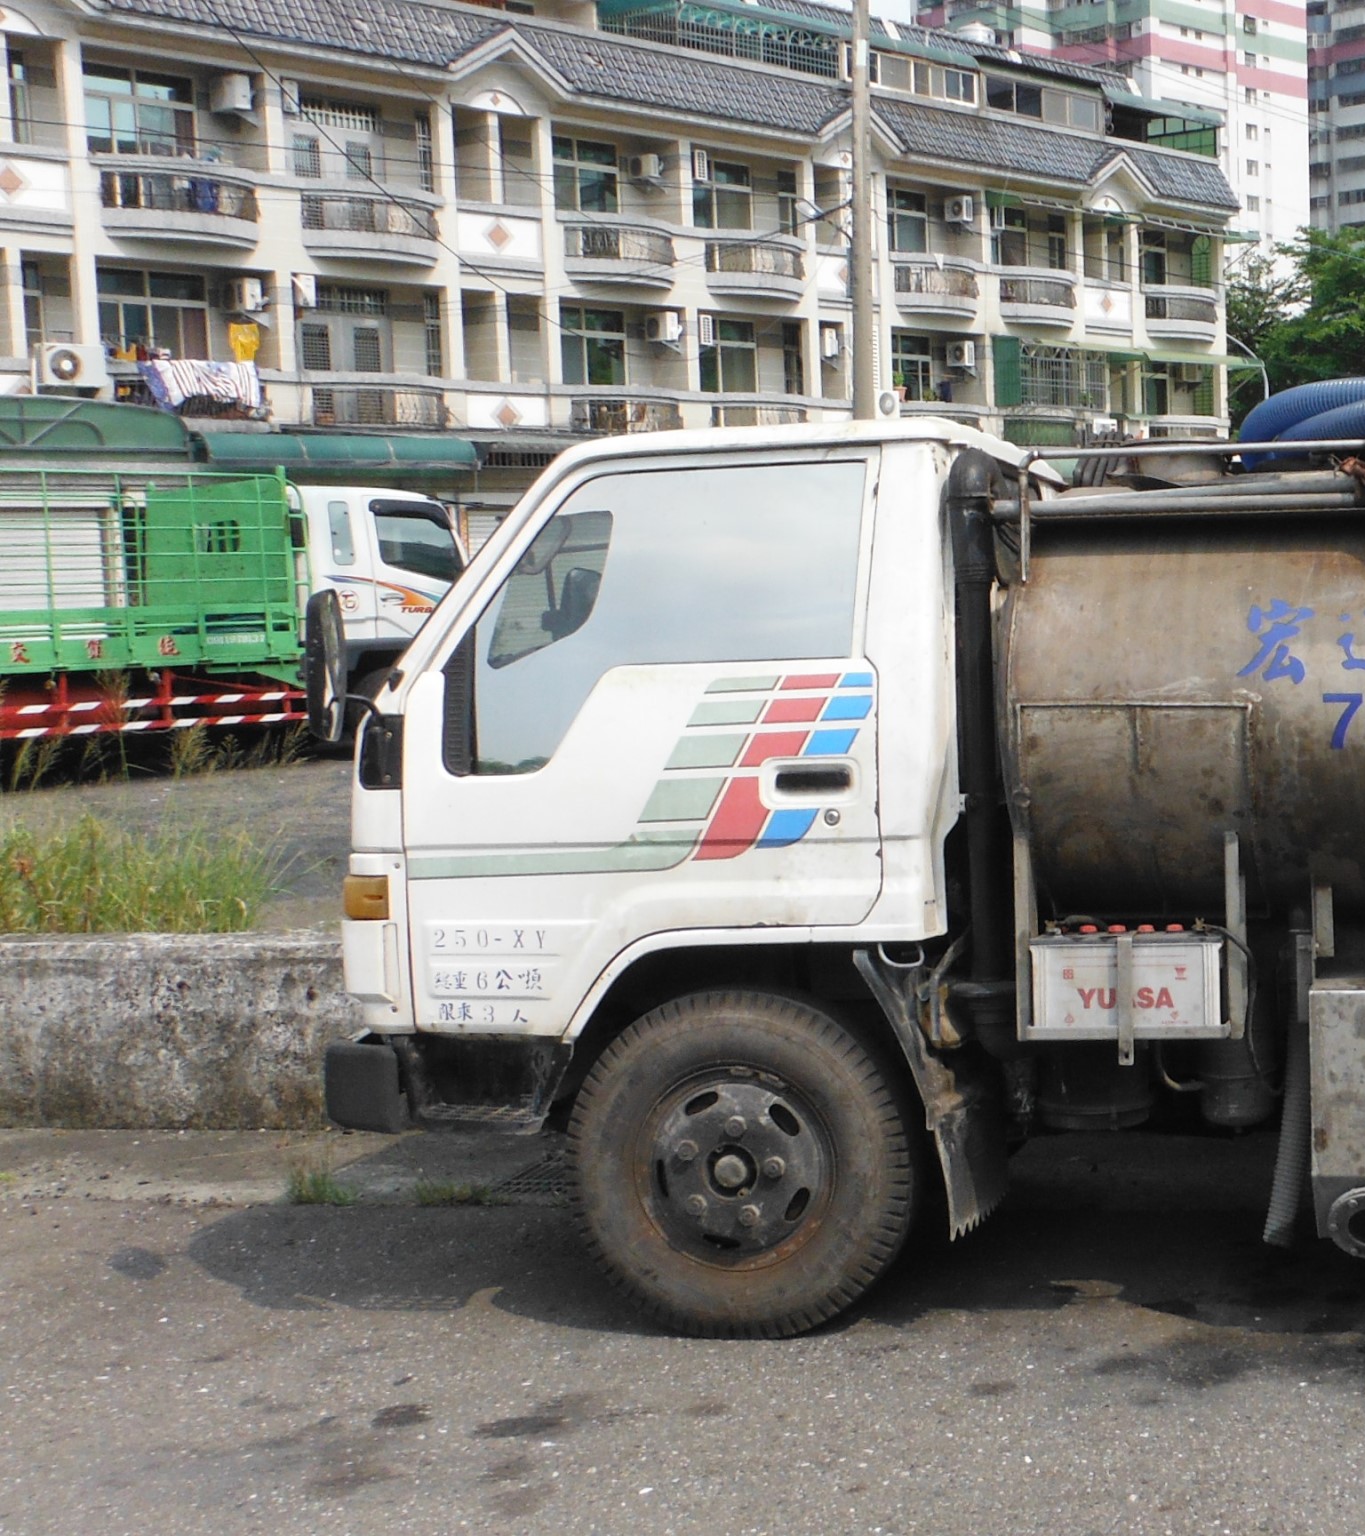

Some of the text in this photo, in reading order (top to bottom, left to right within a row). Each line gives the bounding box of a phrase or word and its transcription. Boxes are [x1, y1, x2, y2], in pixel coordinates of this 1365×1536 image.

[401, 606, 435, 614] TURB
[433, 929, 546, 950] 250-XY
[1077, 986, 1175, 1010] YUSA
